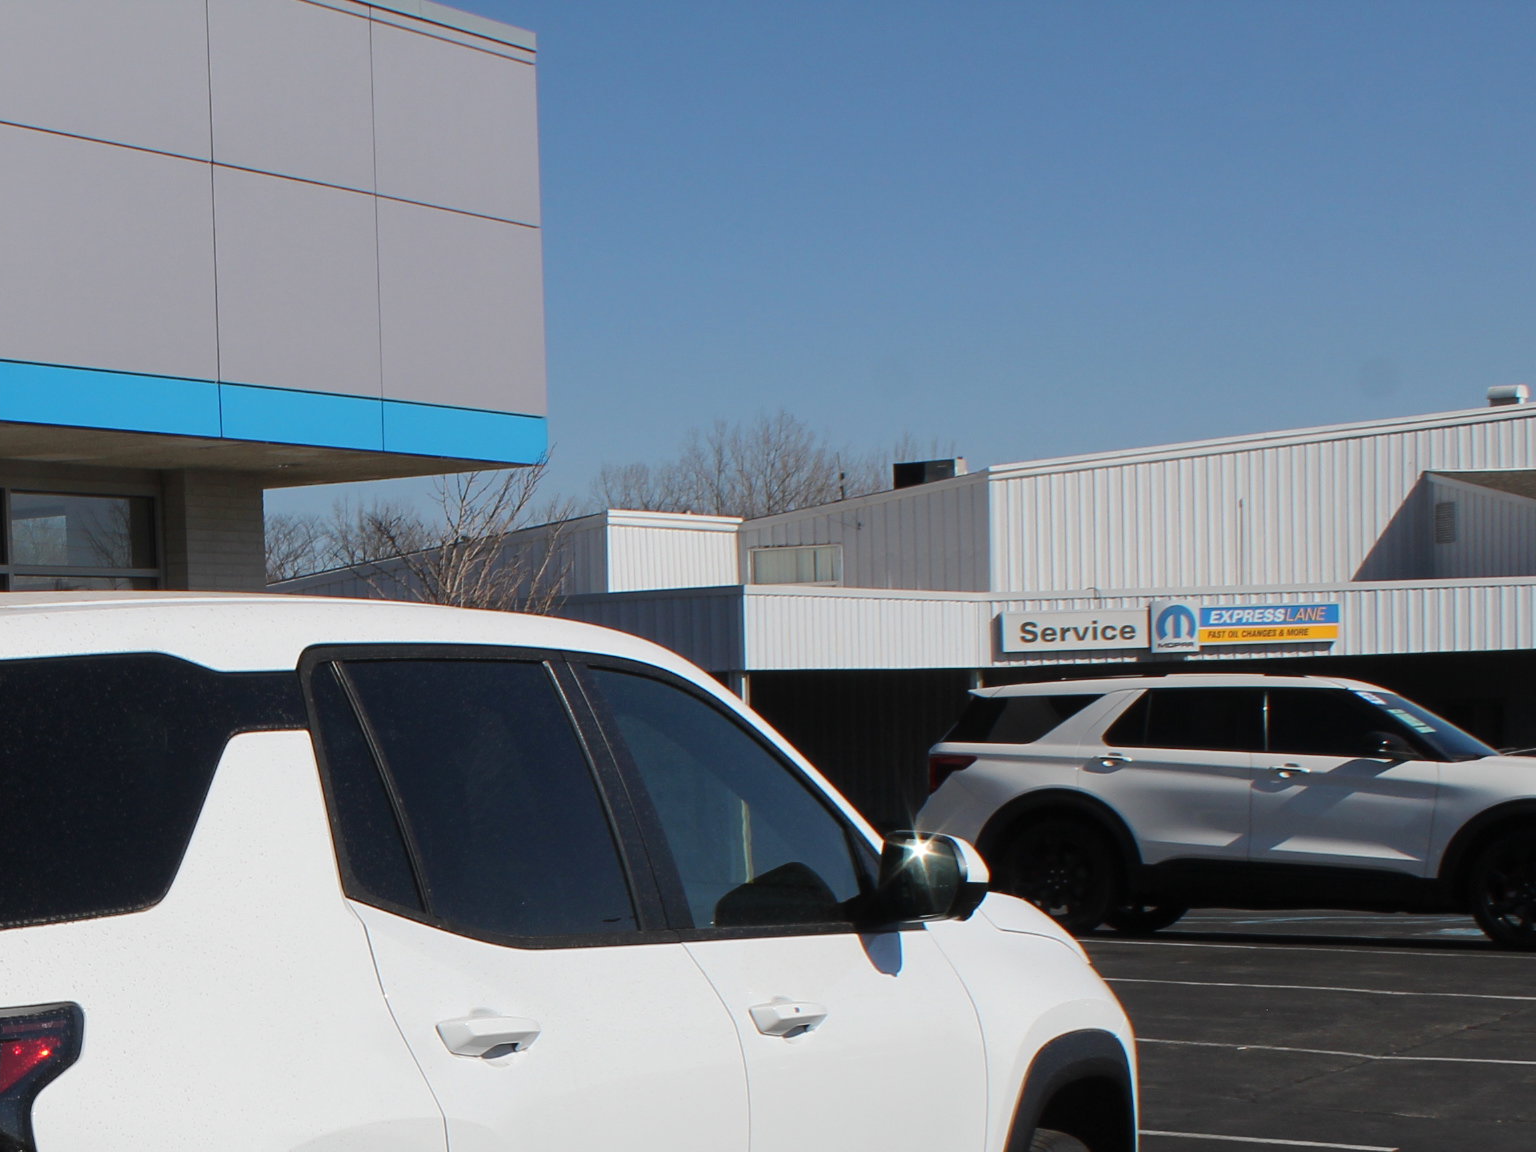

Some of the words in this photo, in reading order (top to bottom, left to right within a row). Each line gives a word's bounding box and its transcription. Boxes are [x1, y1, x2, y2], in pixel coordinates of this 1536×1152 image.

[1019, 620, 1137, 643] Service
[1208, 630, 1226, 638] FAST
[1228, 630, 1239, 638] OIL
[1241, 629, 1277, 638] CHANGES
[1278, 629, 1284, 637] &
[1287, 628, 1310, 637] MORE
